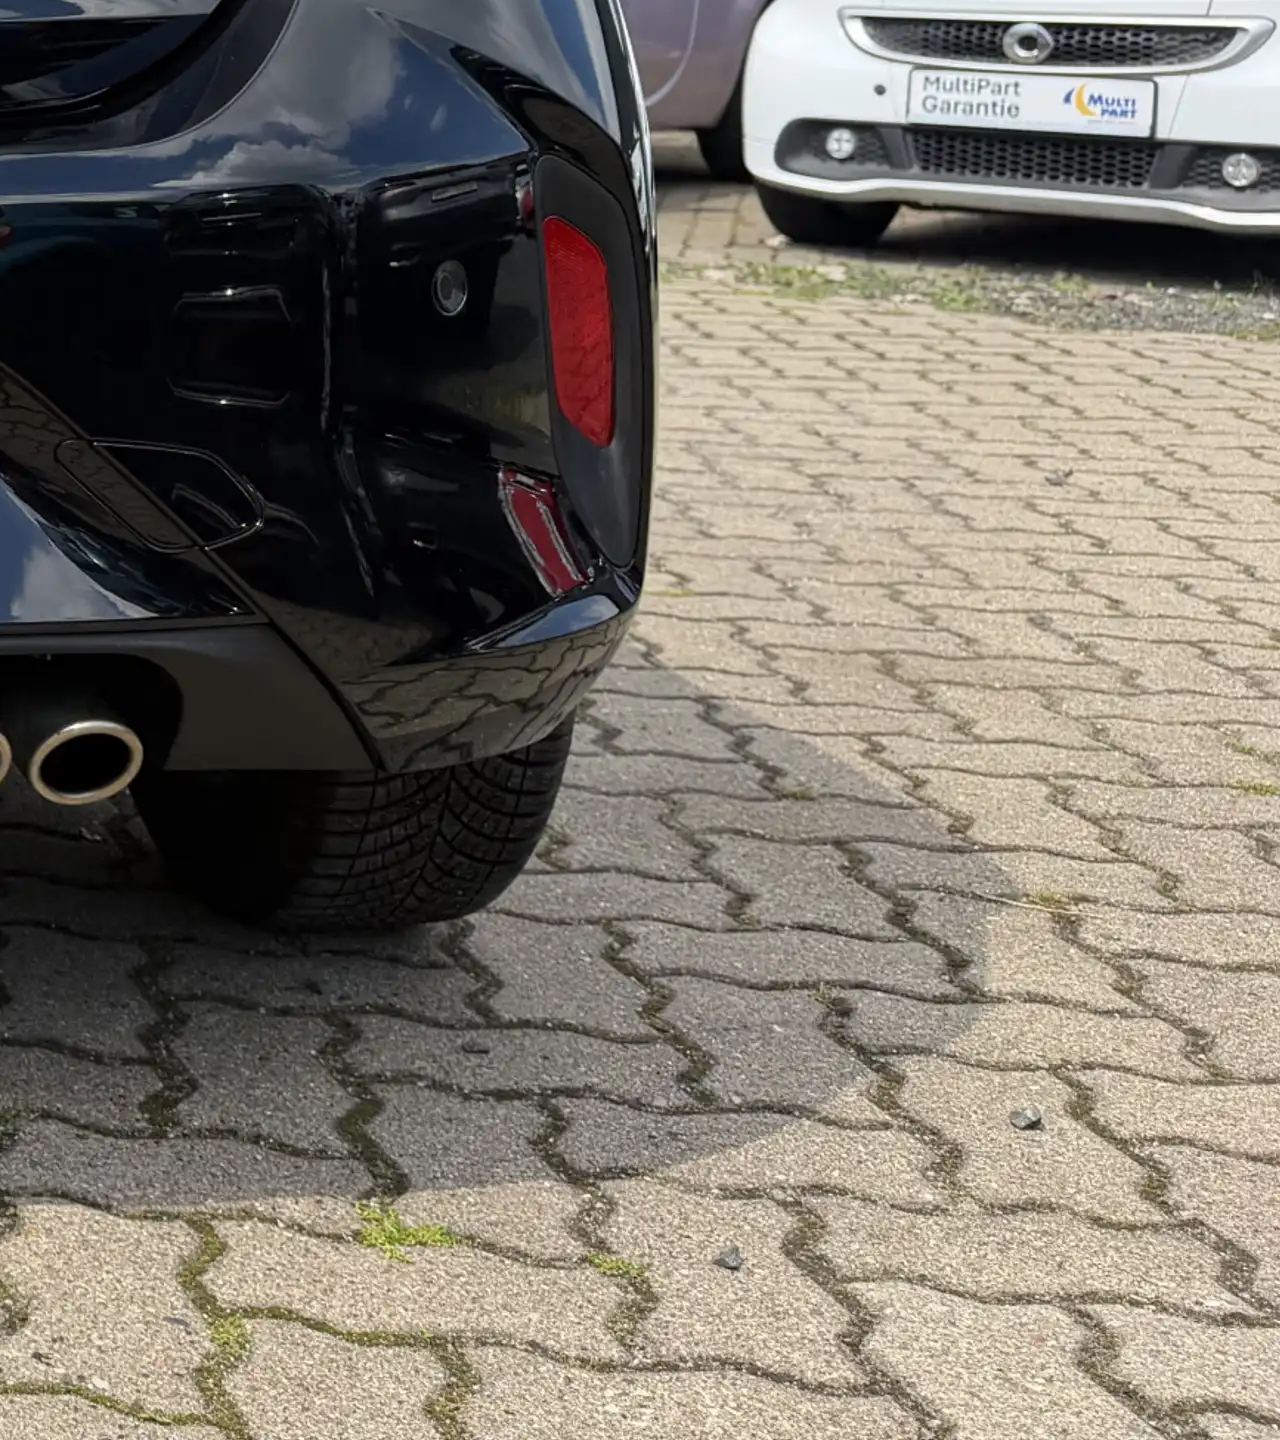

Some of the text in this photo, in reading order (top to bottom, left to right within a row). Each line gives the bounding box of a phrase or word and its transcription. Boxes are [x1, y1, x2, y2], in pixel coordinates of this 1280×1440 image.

[922, 75, 1021, 96] MultiPart
[922, 95, 1021, 119] Garantie
[1087, 93, 1136, 108] MULTI
